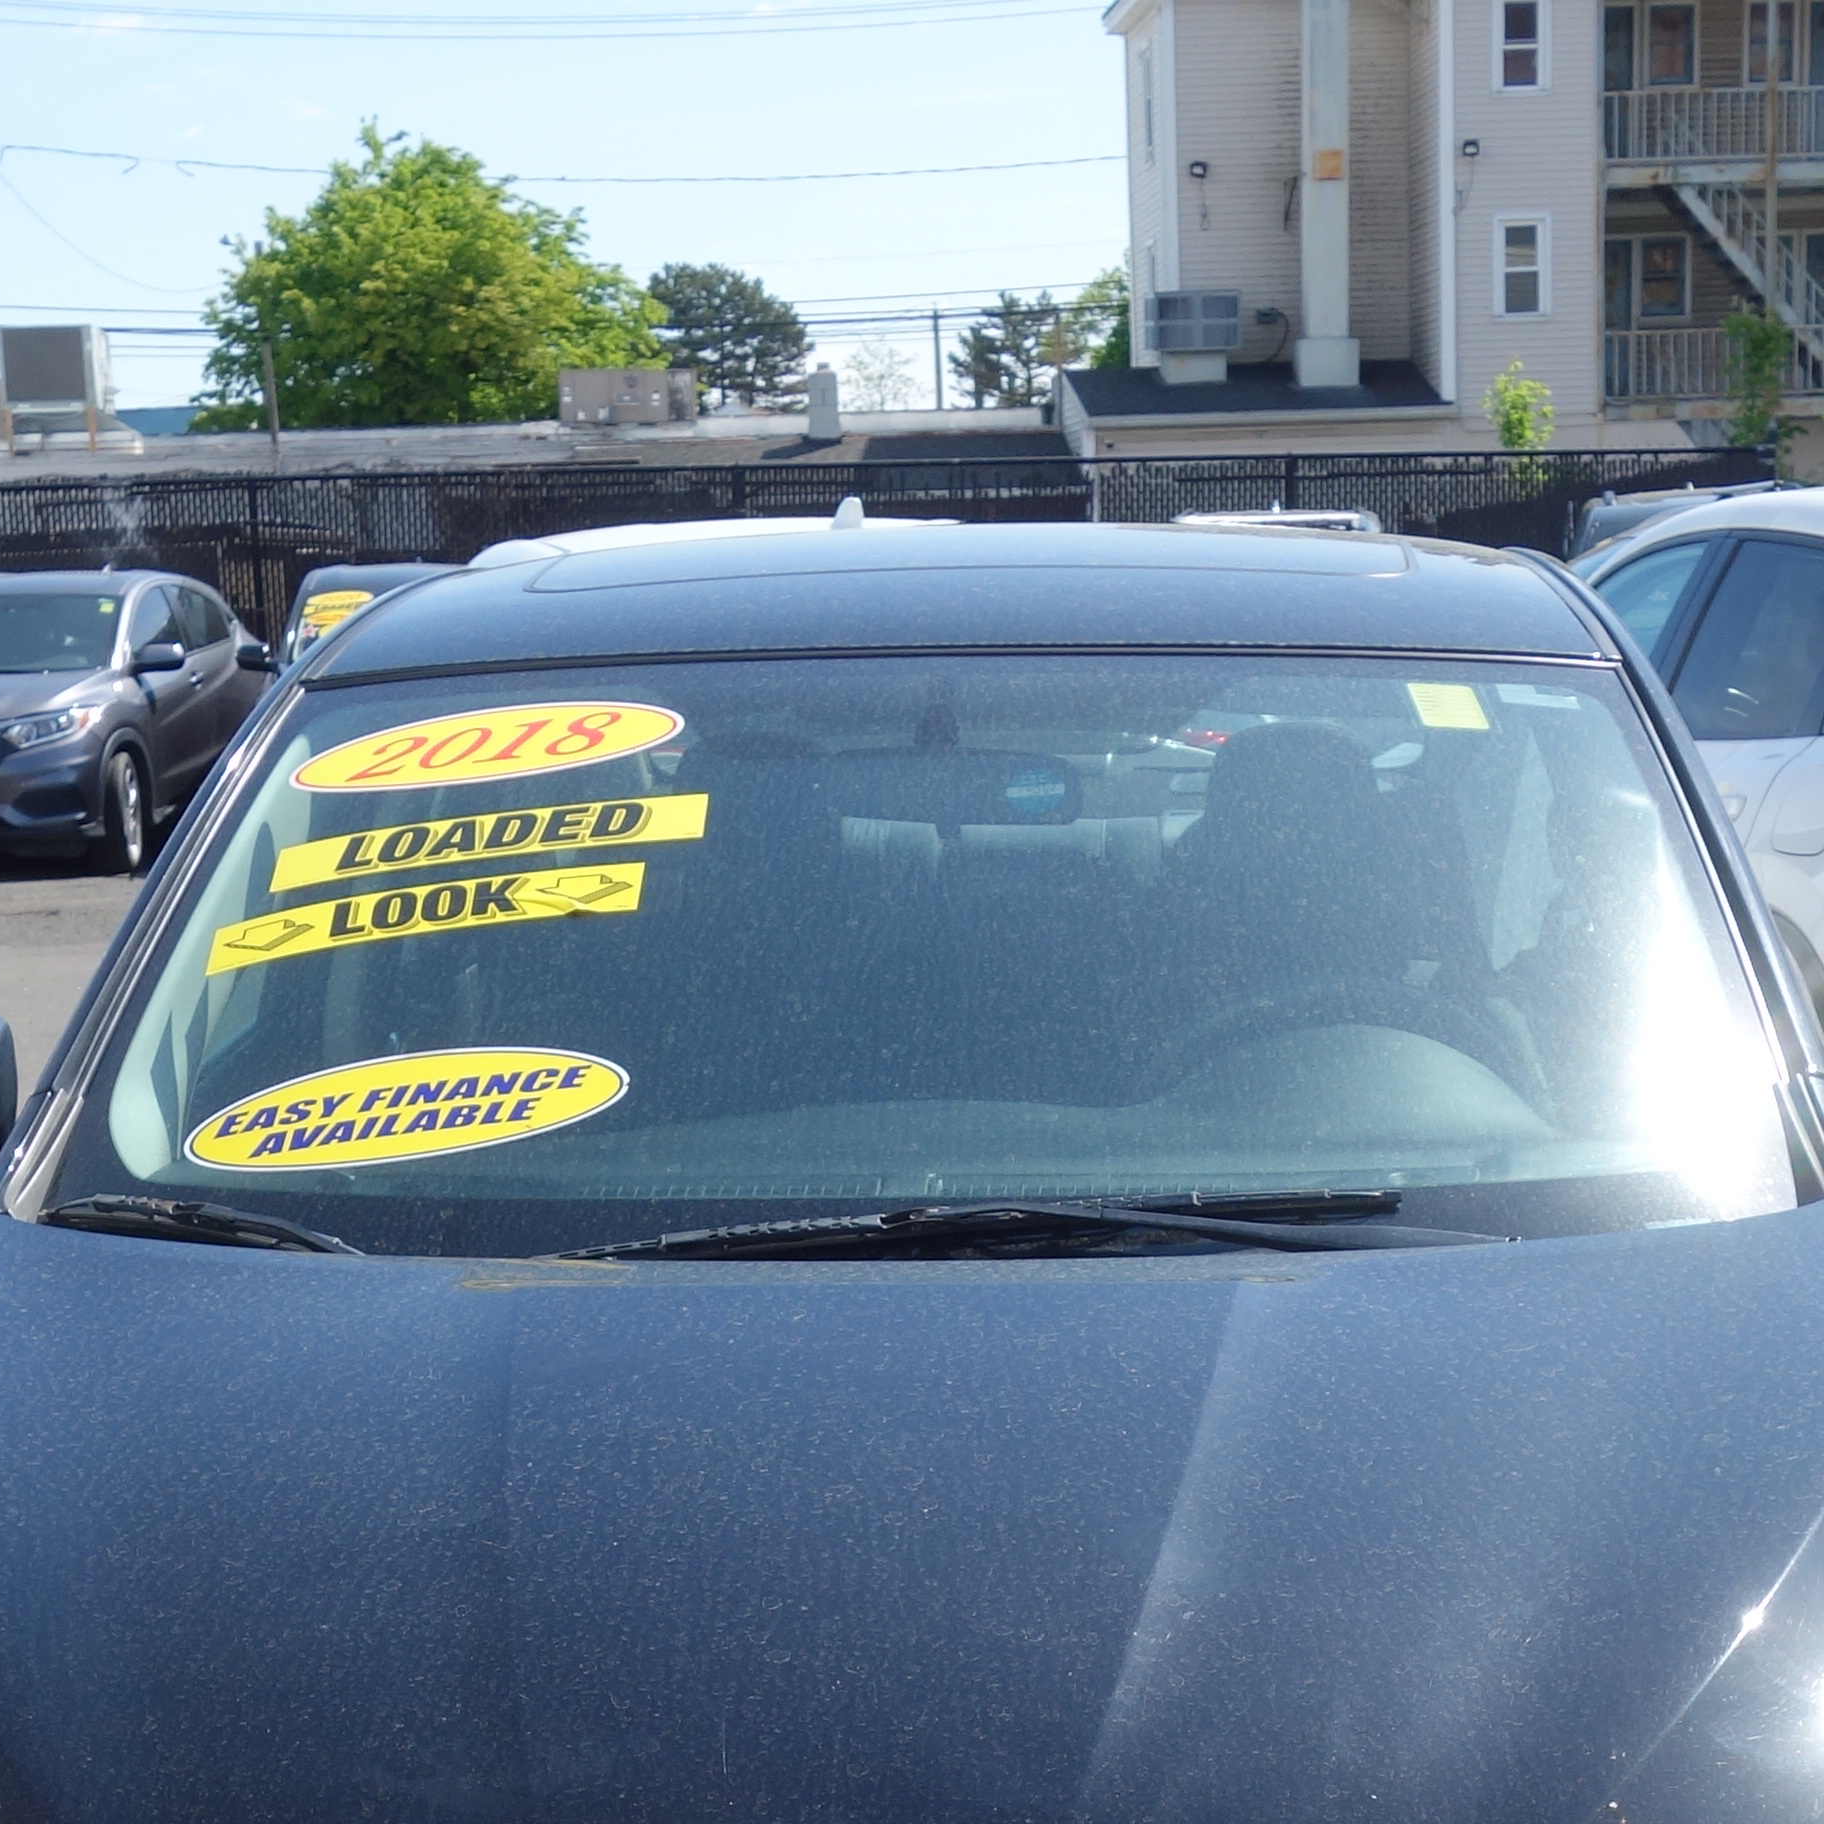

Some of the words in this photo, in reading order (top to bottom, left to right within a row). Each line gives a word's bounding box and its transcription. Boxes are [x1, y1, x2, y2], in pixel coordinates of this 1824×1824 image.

[344, 711, 623, 784] 2018
[334, 801, 651, 874] LOADED
[328, 877, 528, 941] LOOK
[213, 1092, 354, 1140] EASY
[365, 1064, 594, 1109] FINANCE
[246, 1097, 543, 1160] AVAILABLE
